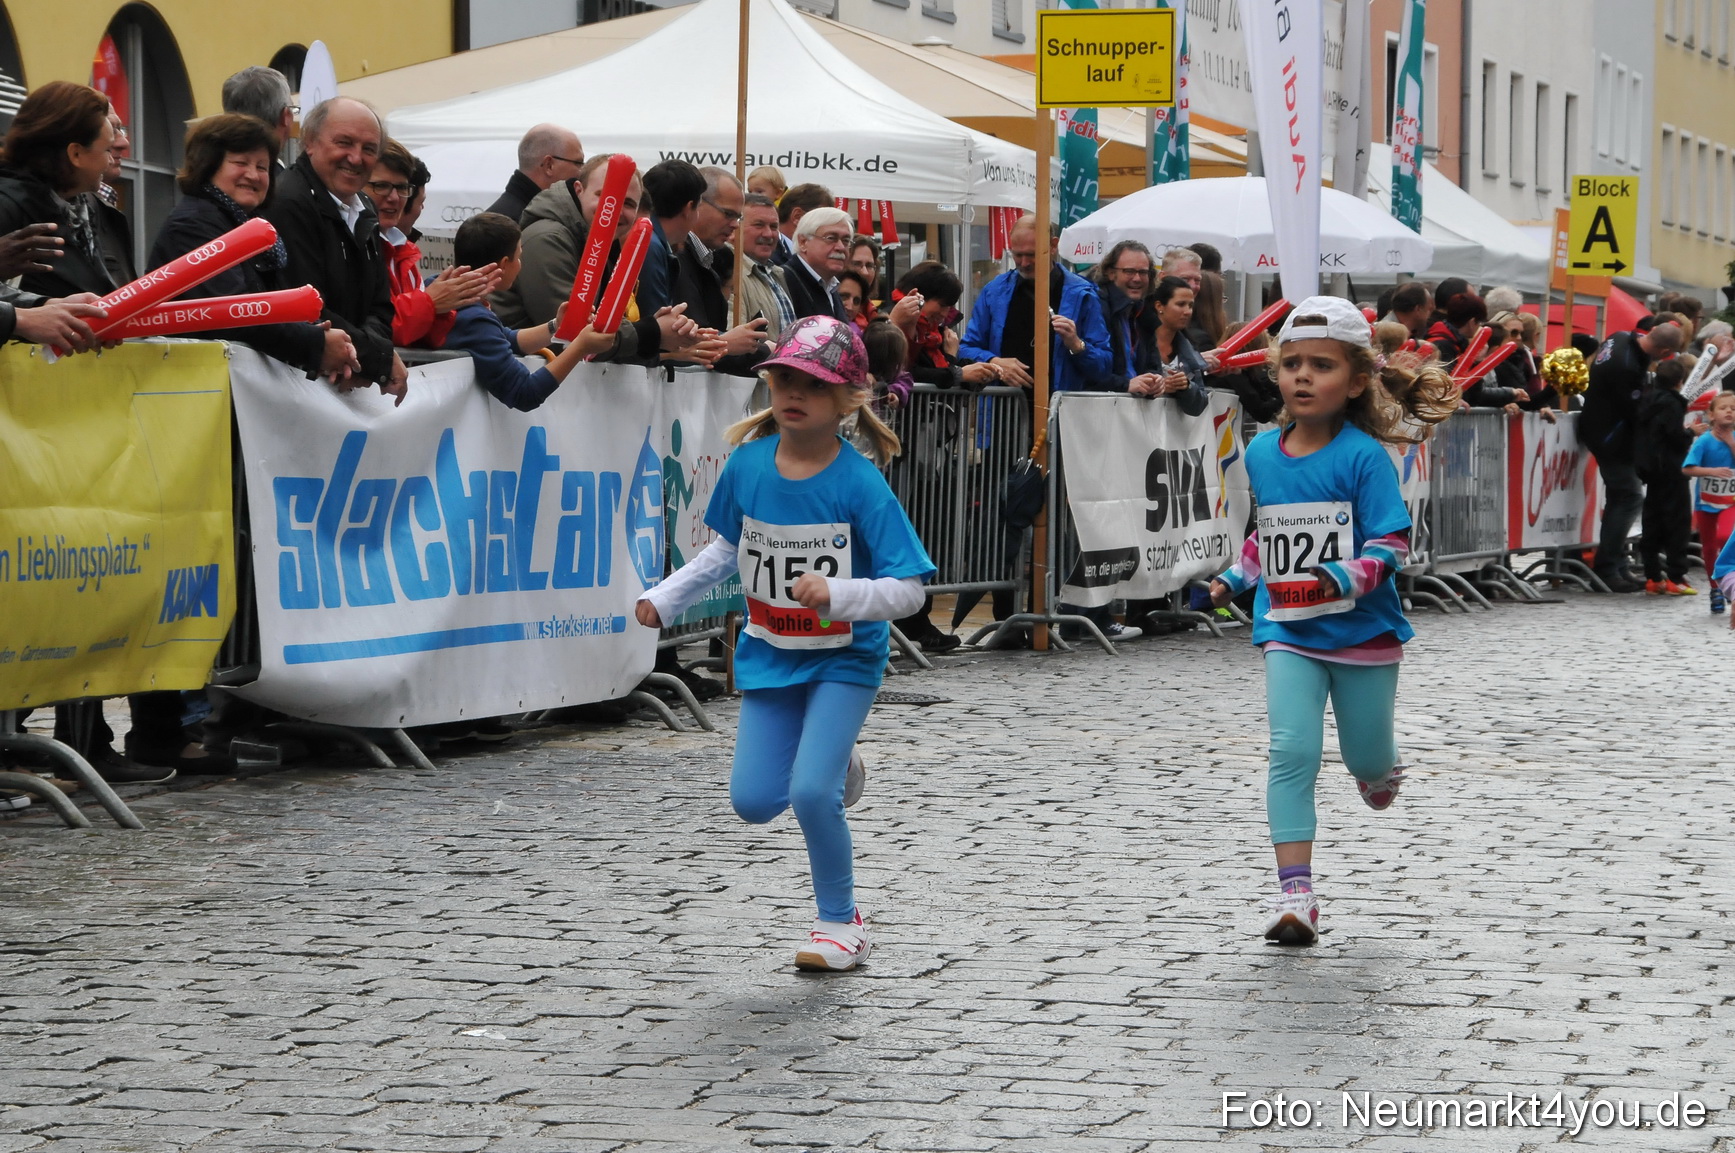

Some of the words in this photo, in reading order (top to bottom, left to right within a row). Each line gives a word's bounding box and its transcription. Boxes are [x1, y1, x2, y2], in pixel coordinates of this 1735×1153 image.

[1047, 38, 1165, 60] Schnupper-
[1087, 64, 1125, 82] lauf
[659, 149, 898, 174] www.audibkk.de
[982, 160, 1001, 181] Von
[1578, 178, 1630, 197] Block
[1581, 205, 1620, 254] A
[577, 271, 594, 302] Audi
[587, 238, 604, 268] BKK
[1256, 253, 1279, 267] Au
[1319, 253, 1347, 267] KK
[97, 285, 137, 310] Audi
[138, 266, 175, 291] BKK
[126, 312, 169, 328] Audi
[175, 307, 212, 323] BKK
[1703, 477, 1735, 493] 7578
[1277, 514, 1331, 527] Neumarkt
[766, 537, 827, 549] Neumarkt
[1262, 531, 1343, 577] 7024
[158, 563, 219, 625] KANN
[523, 612, 613, 640] www.slackstar.net
[765, 609, 813, 633] Sophie
